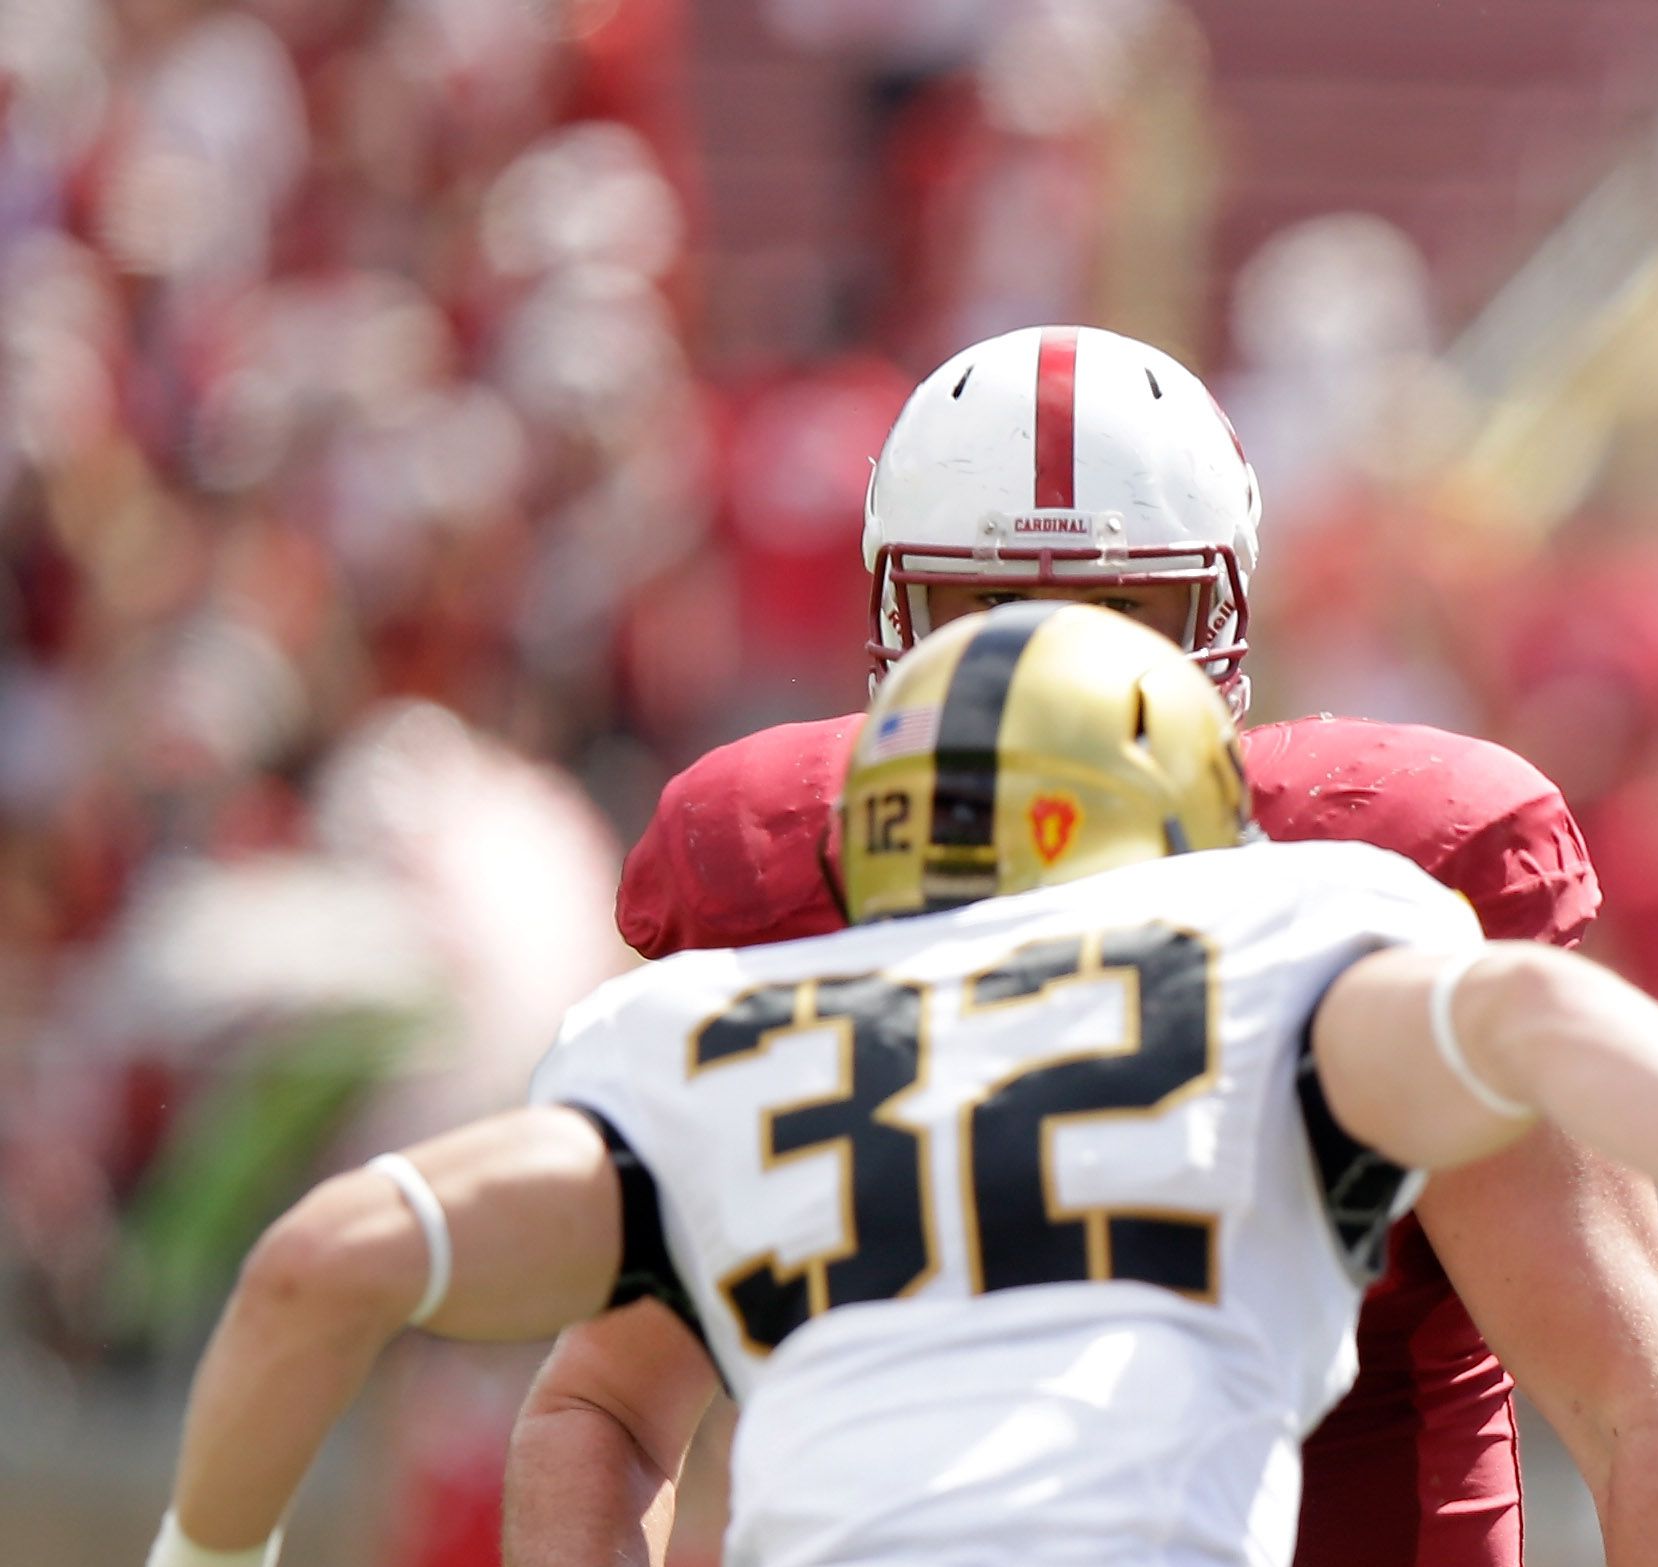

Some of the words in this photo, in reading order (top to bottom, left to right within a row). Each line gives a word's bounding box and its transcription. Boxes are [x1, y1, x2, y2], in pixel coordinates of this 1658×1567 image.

[1014, 517, 1088, 534] CARDINAL
[865, 790, 912, 855] 12
[685, 918, 1222, 1362] 32
